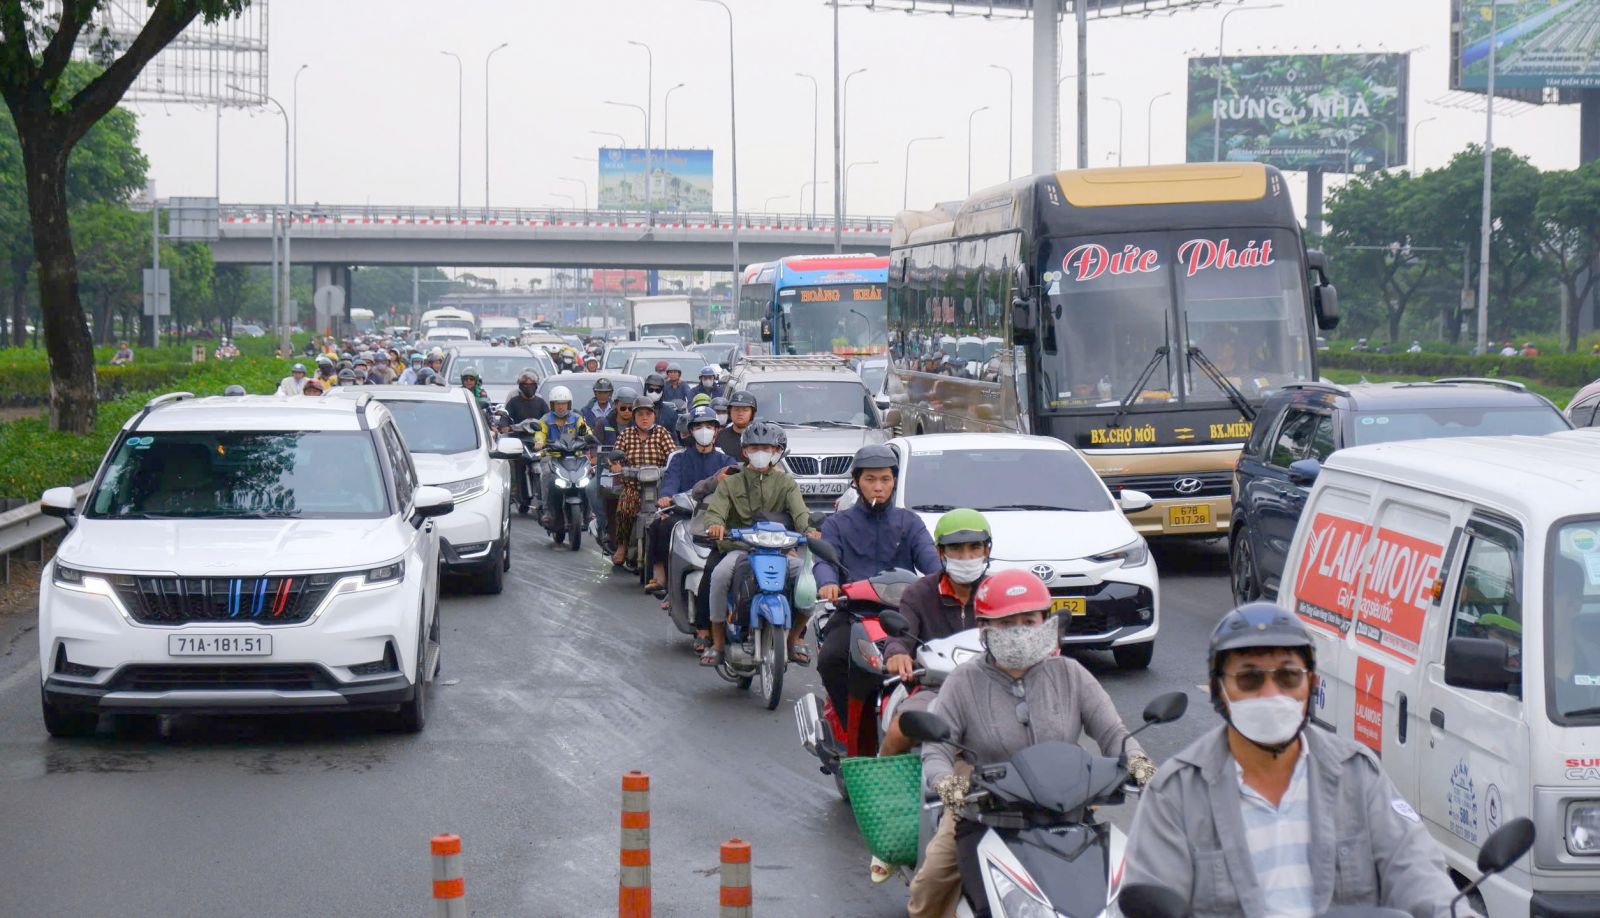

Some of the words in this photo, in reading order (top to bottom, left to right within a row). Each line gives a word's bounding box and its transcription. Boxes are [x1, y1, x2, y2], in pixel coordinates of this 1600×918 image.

[1312, 92, 1370, 118] NHÀ
[1062, 243, 1160, 281] Đức
[1177, 238, 1275, 277] Phát
[801, 287, 841, 302] HOÀNG
[1091, 426, 1133, 447] BX.CHỢ
[1135, 424, 1156, 442] MỚI
[820, 484, 842, 493] 2740
[1181, 506, 1198, 516] 67B
[1174, 515, 1206, 525] 017.28
[178, 638, 262, 652] 71A-181.51
